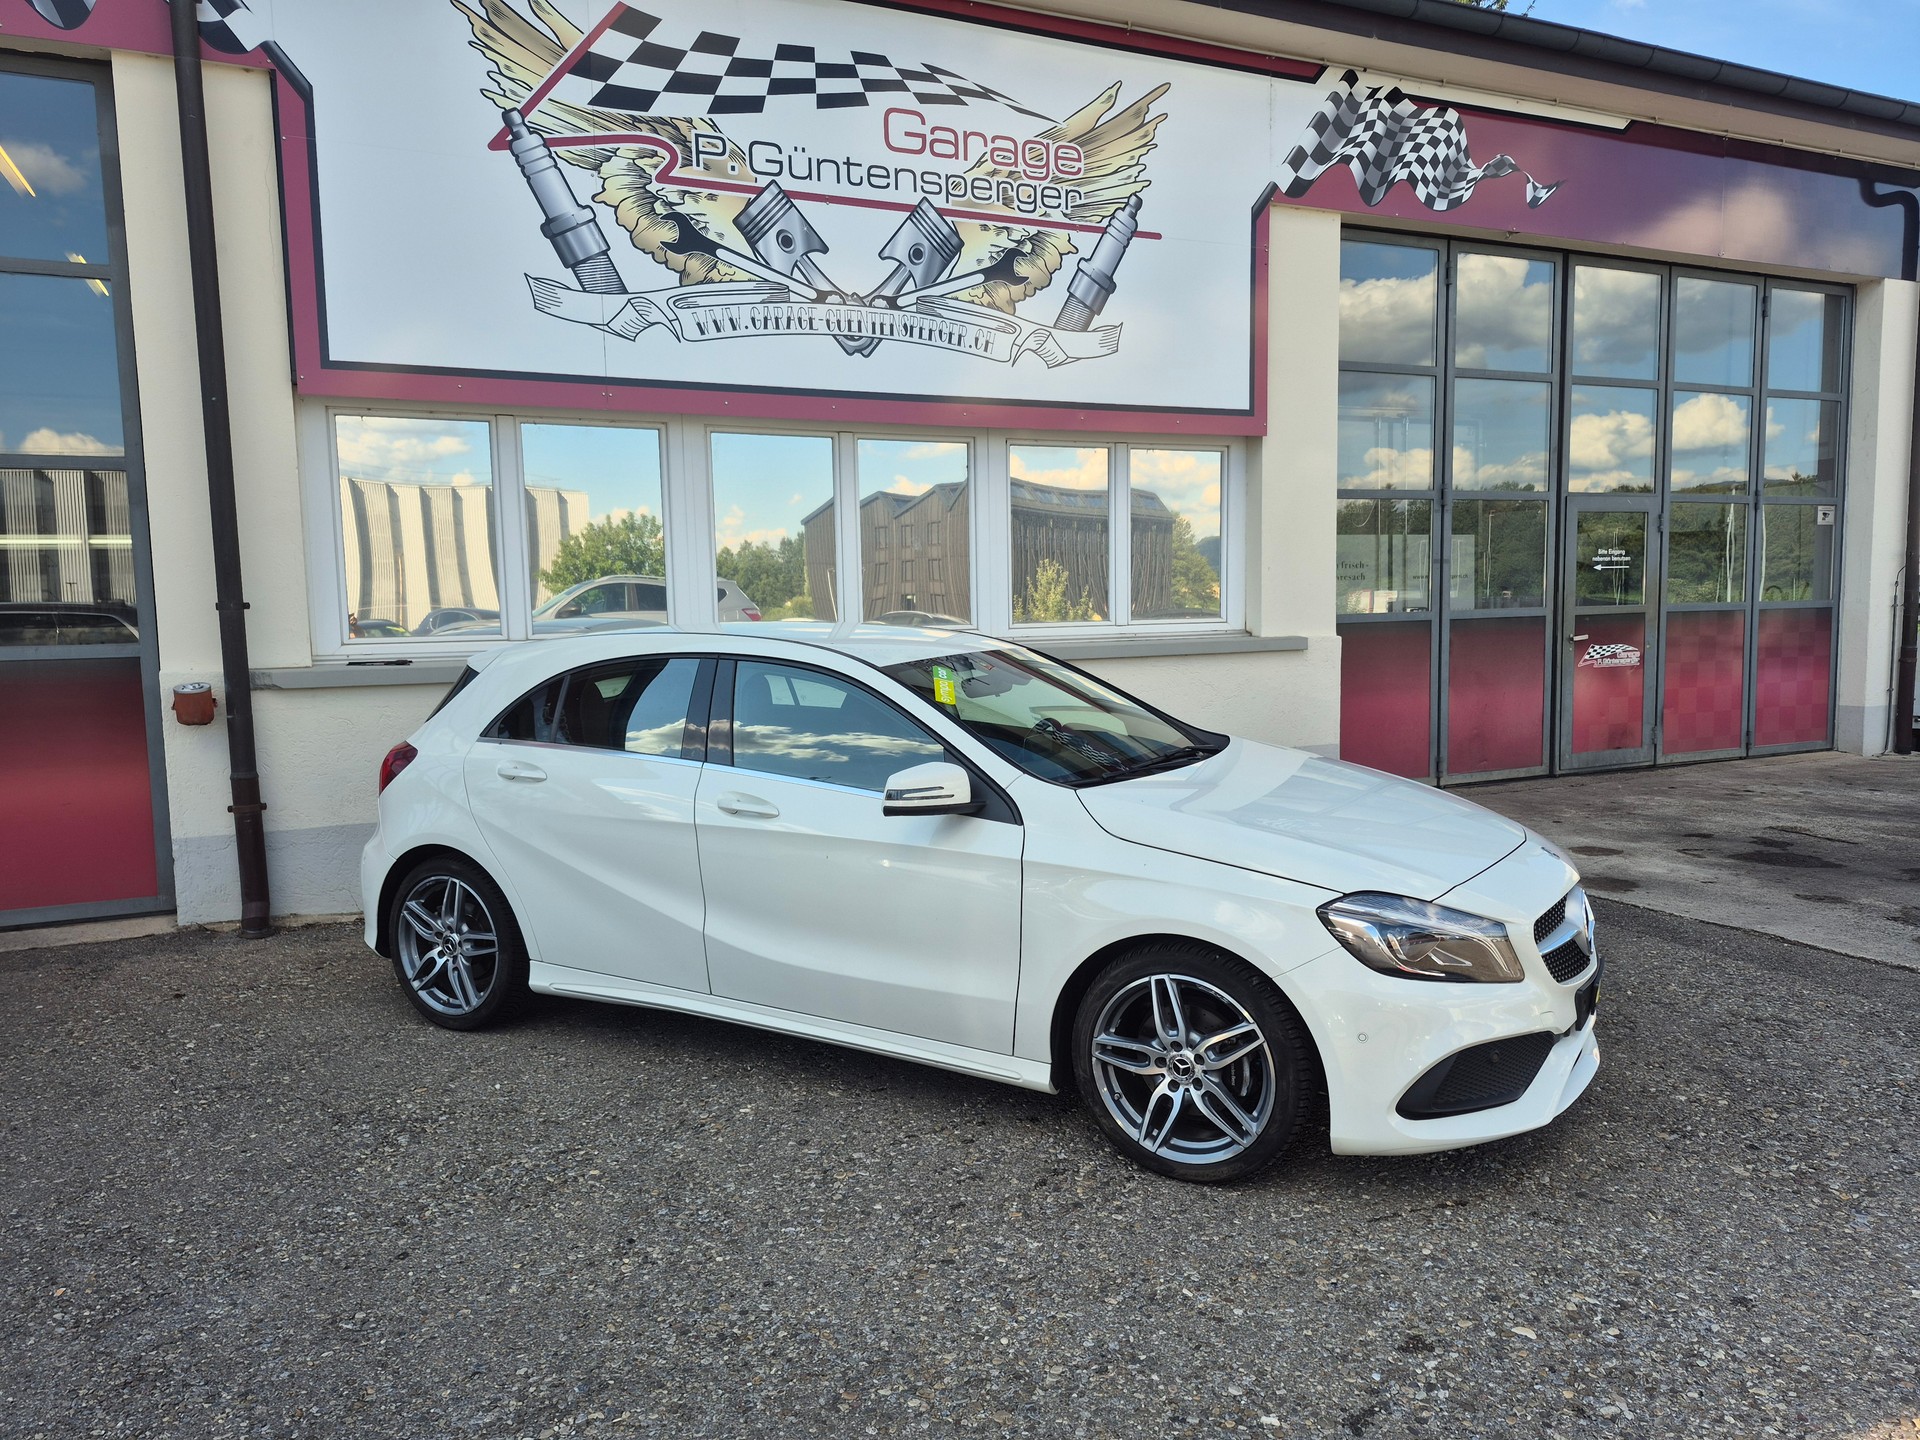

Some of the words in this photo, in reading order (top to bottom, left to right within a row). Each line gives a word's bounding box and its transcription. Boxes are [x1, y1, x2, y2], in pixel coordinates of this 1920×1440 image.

[749, 140, 1082, 213] Güntensperger
[884, 107, 1082, 181] Garage
[692, 306, 997, 354] WWW.GARAGE-GUENTENSPERGER.CH
